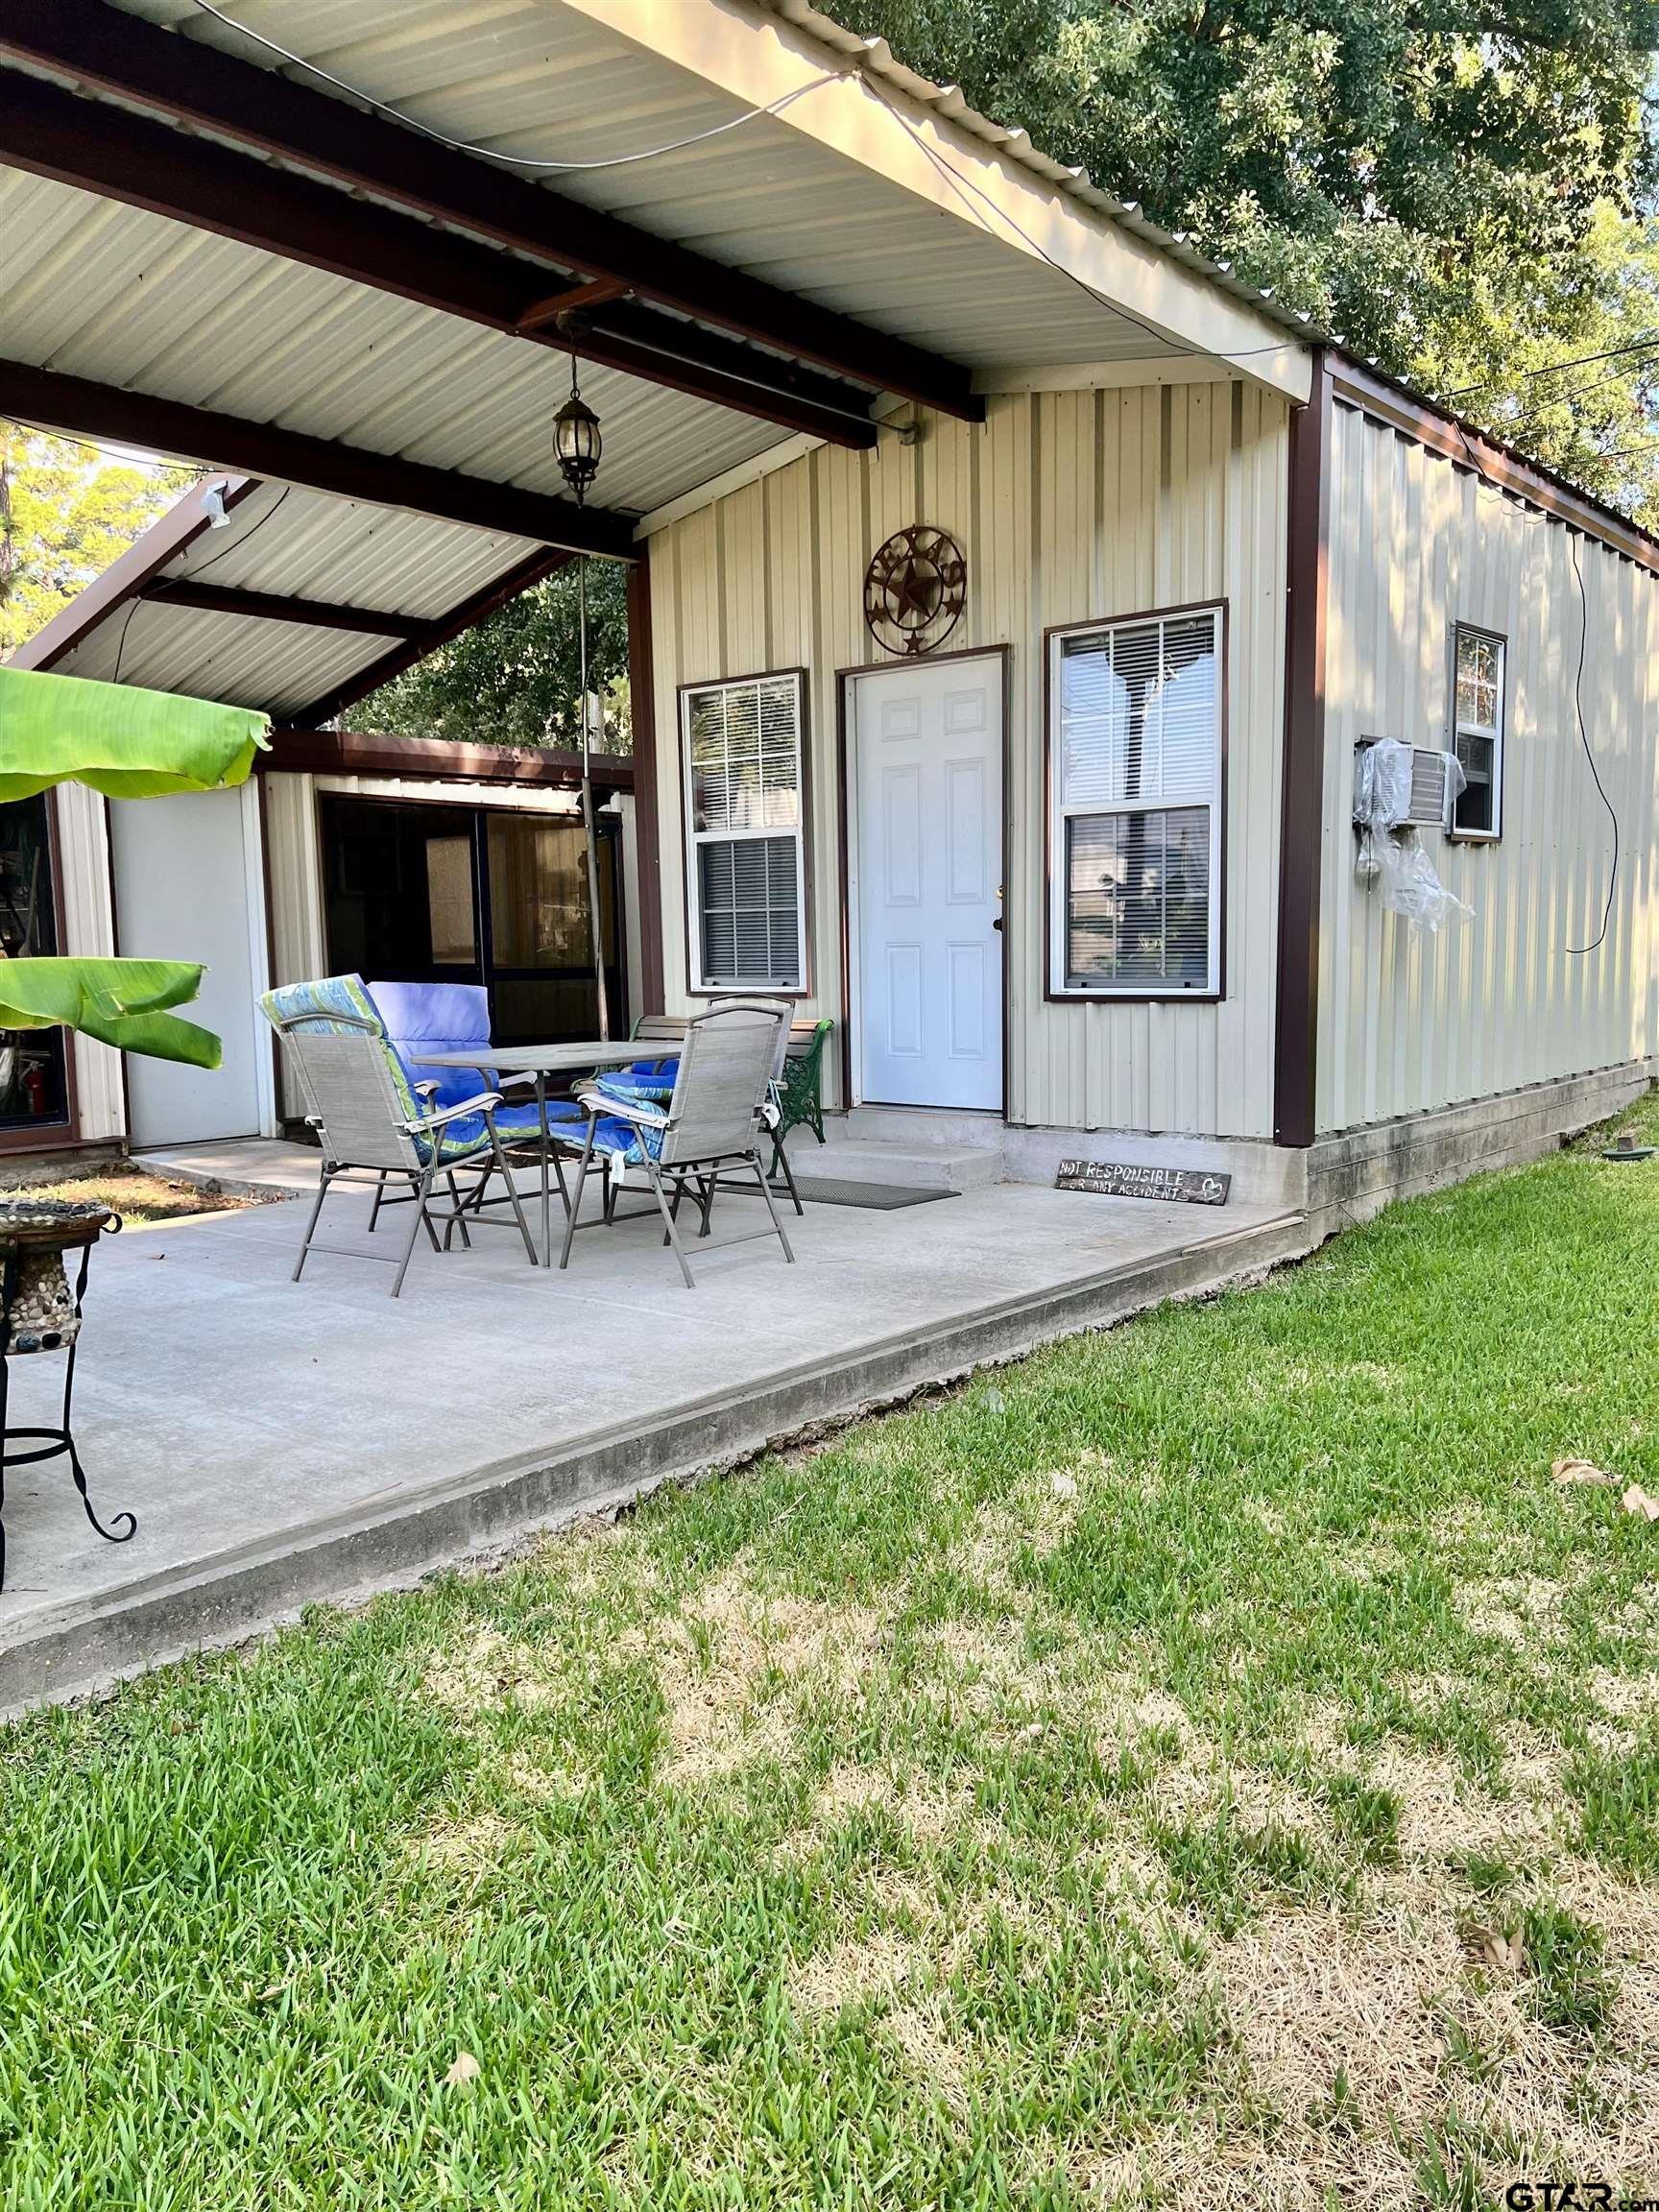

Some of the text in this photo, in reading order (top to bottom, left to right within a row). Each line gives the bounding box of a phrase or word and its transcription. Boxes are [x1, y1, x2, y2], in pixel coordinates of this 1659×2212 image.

[1059, 1161, 1185, 1187] NOT RESPONSIBLE
[1093, 1180, 1116, 1194] ANY
